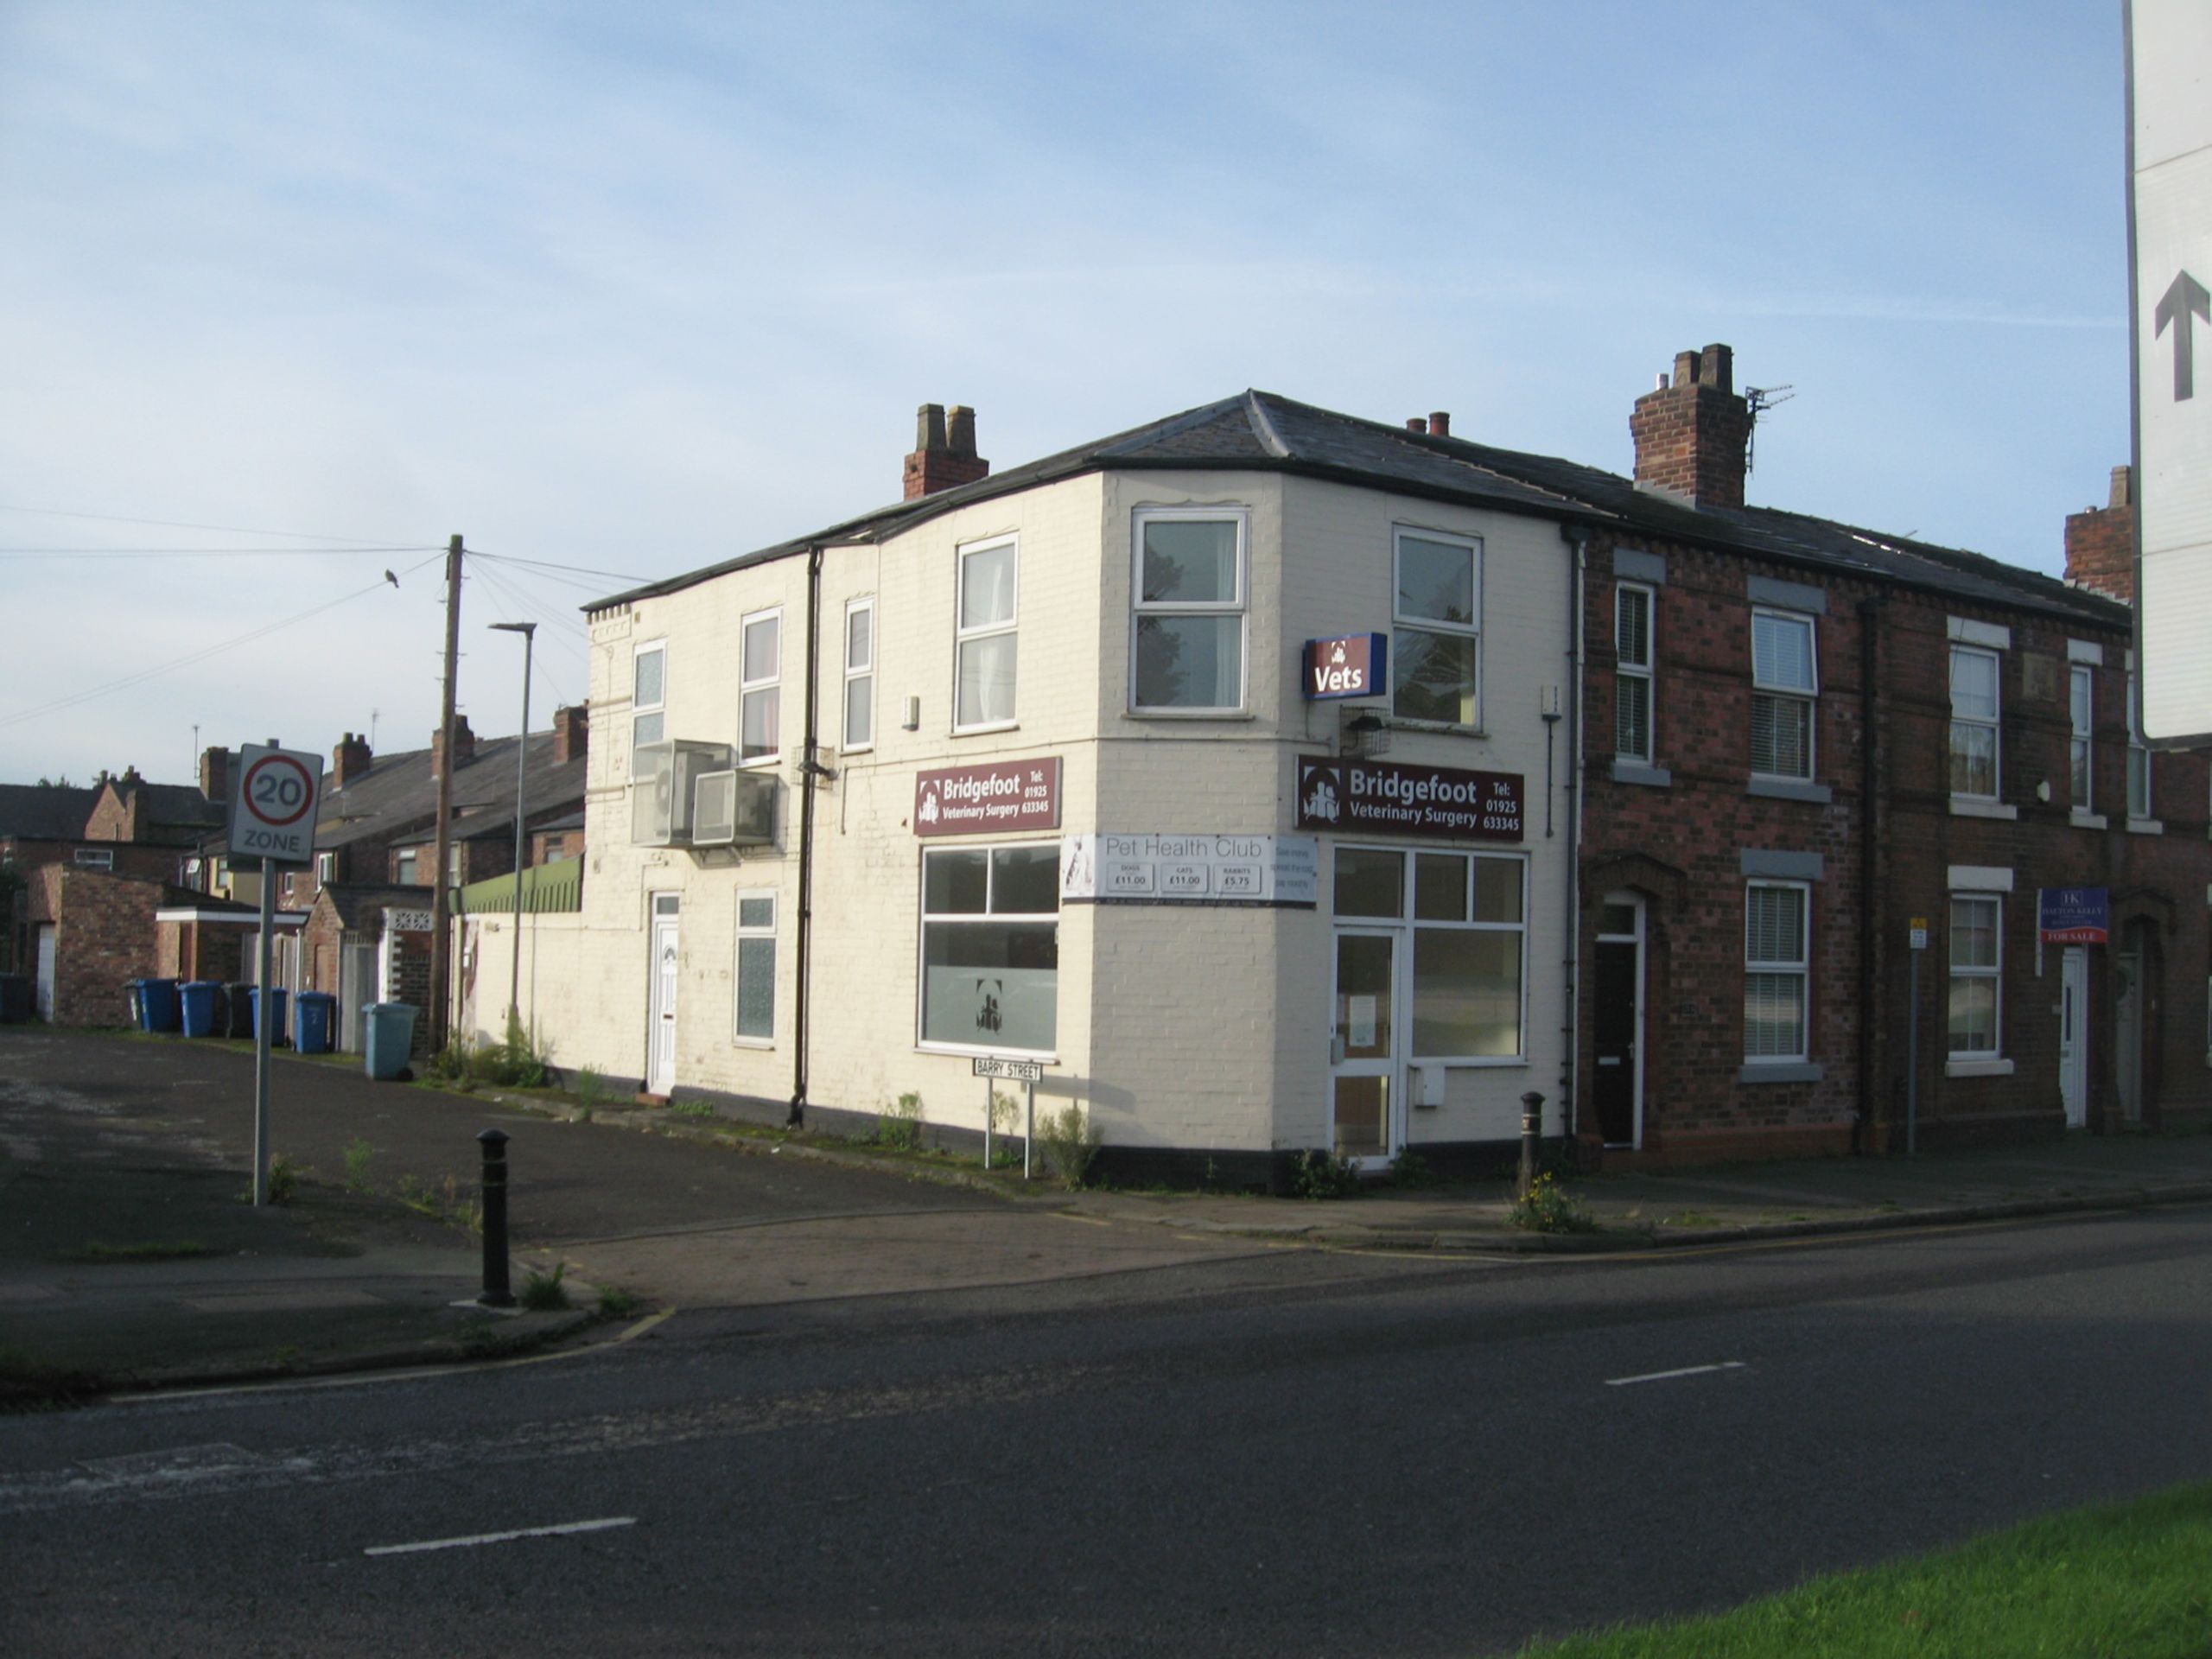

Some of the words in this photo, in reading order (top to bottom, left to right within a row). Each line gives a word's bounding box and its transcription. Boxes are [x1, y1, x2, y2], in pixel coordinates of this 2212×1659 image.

[1314, 666, 1363, 692] Vets
[254, 773, 302, 806] 20
[944, 773, 1020, 803] Bridgefoot
[1024, 785, 1047, 798] 01925
[1350, 768, 1477, 805] Bridgefoot
[1493, 782, 1510, 797] Tel:
[943, 805, 985, 820] Veterinary
[985, 803, 1020, 818] Surgery
[1021, 800, 1049, 814] 633345
[1485, 799, 1516, 813] 01925
[1350, 801, 1422, 824] Veterinary
[1425, 807, 1478, 829] Surgery
[1483, 817, 1520, 831] 633345
[244, 829, 301, 853] ZONE
[1106, 838, 1137, 856] Pet
[1145, 838, 1209, 858] Health
[1216, 838, 1262, 858] Club
[1121, 864, 1141, 873] DOGS
[1116, 875, 1146, 886] £11.00
[1169, 875, 1200, 886] £11.00
[1224, 876, 1250, 887] £5.75
[2047, 932, 2068, 941] FOR
[2069, 932, 2095, 941] SALE
[977, 1059, 1004, 1076] BARRY
[1007, 1063, 1039, 1079] STREET
